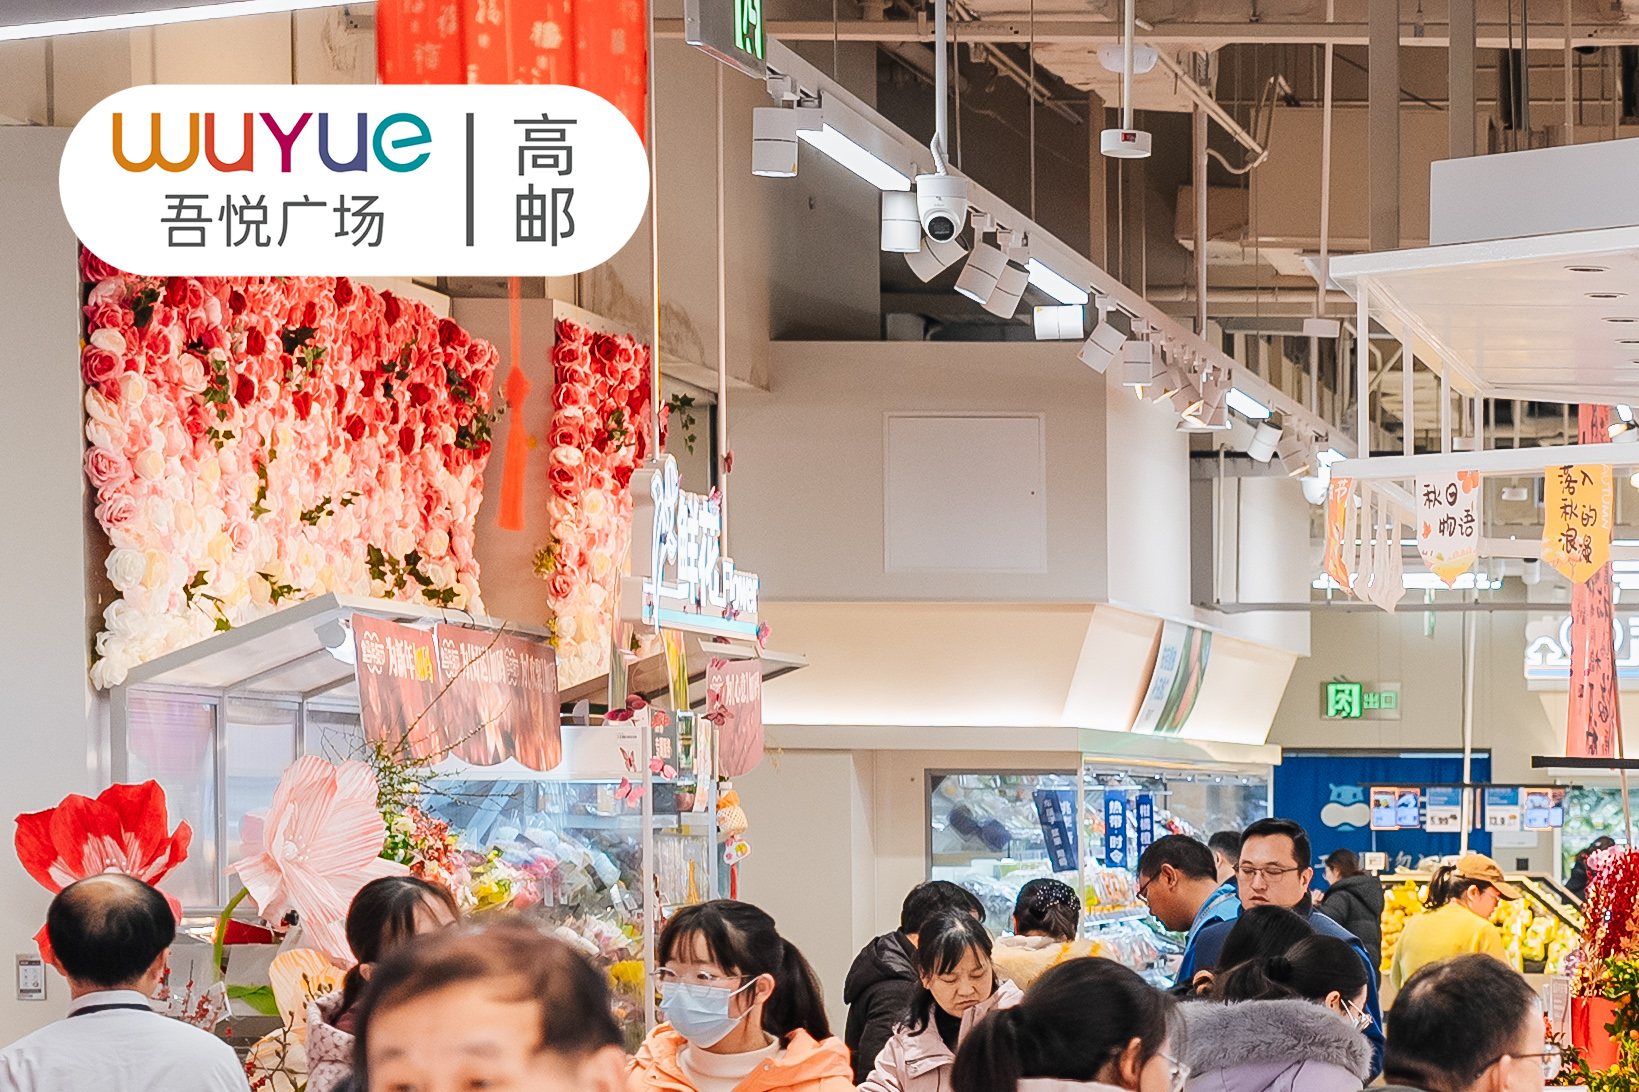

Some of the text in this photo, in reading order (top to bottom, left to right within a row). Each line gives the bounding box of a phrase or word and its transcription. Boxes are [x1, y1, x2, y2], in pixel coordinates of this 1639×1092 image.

[1423, 483, 1458, 510] 秋日
[1438, 509, 1475, 537] 物语
[1363, 691, 1398, 710] 出口
